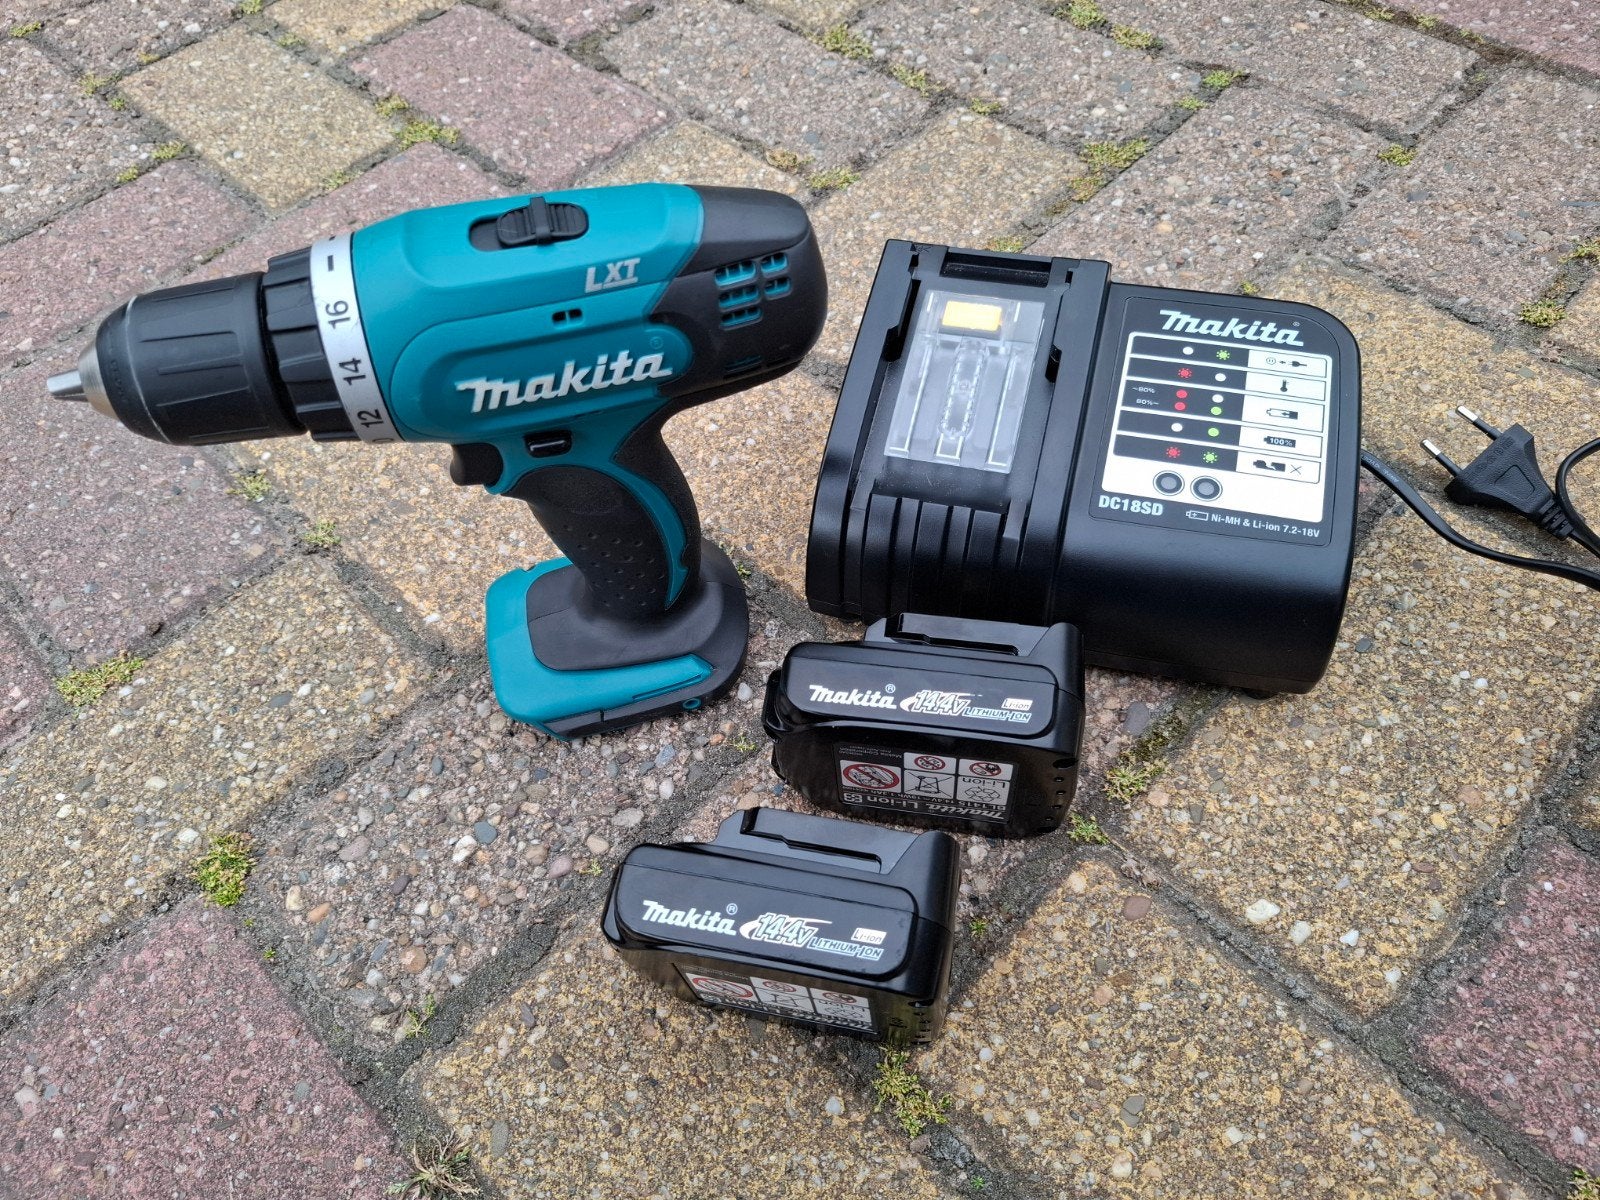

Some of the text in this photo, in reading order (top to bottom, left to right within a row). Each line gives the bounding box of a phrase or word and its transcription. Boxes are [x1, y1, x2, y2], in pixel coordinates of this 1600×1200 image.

[584, 257, 640, 293] LXT
[325, 300, 351, 330] 16
[338, 357, 366, 386] 14
[356, 408, 384, 429] 12
[1269, 437, 1294, 447] 100%
[1098, 494, 1164, 517] DC18SD
[1211, 513, 1320, 538] Ni-MH & Li-ion 7.2-18V
[962, 776, 1006, 789] Li-ion
[866, 796, 919, 809] Li-ion
